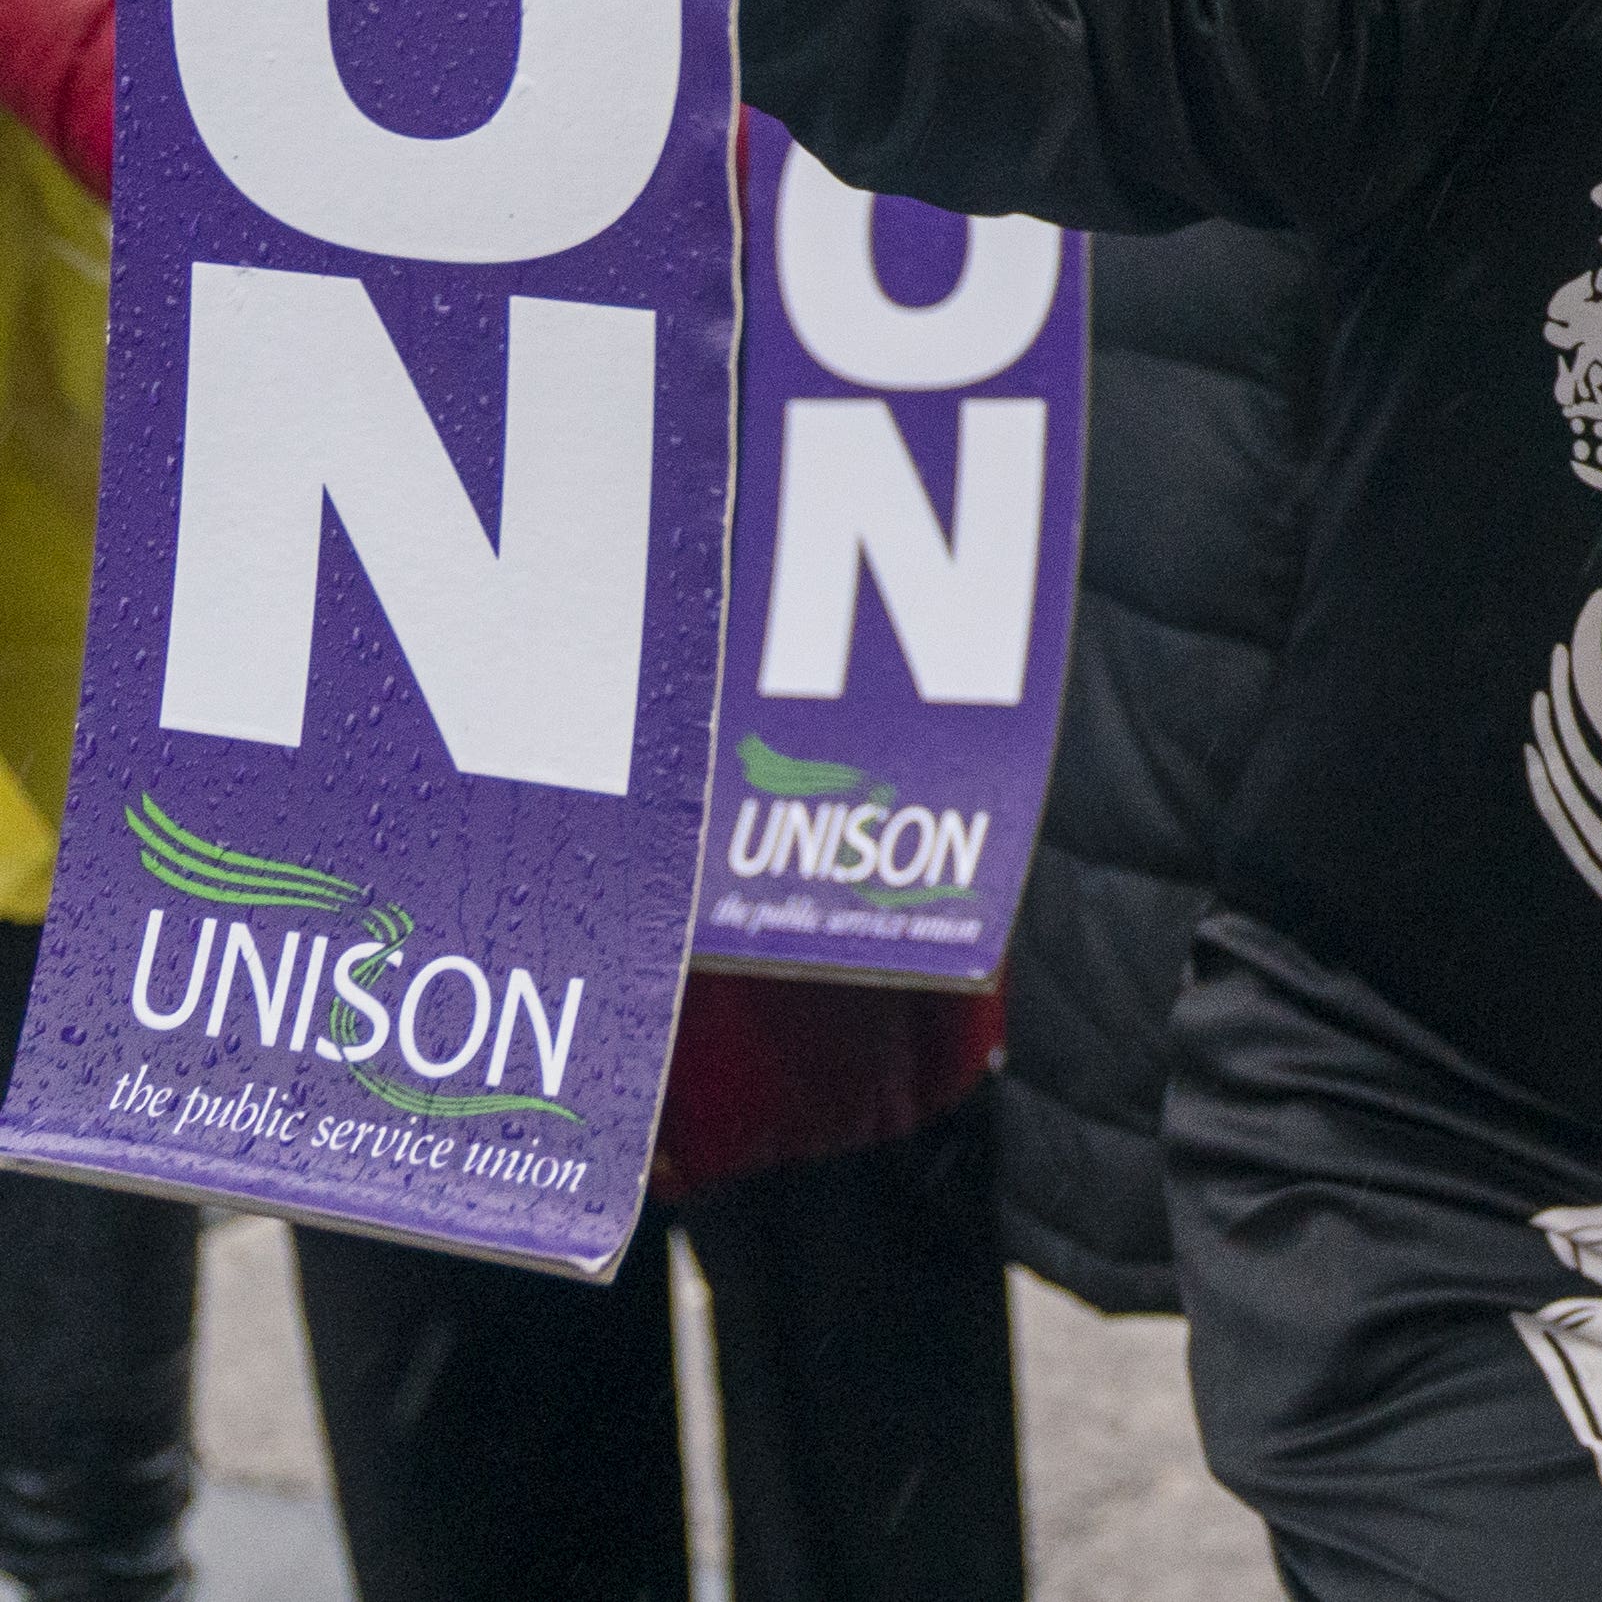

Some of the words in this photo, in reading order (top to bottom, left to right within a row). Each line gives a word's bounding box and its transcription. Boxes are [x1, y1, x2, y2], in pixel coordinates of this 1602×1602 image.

[728, 797, 991, 888] UNISON
[131, 908, 586, 1097] UNISON
[108, 1064, 176, 1118] the
[173, 1082, 305, 1143] public
[311, 1114, 455, 1170] service
[463, 1138, 588, 1193] union
